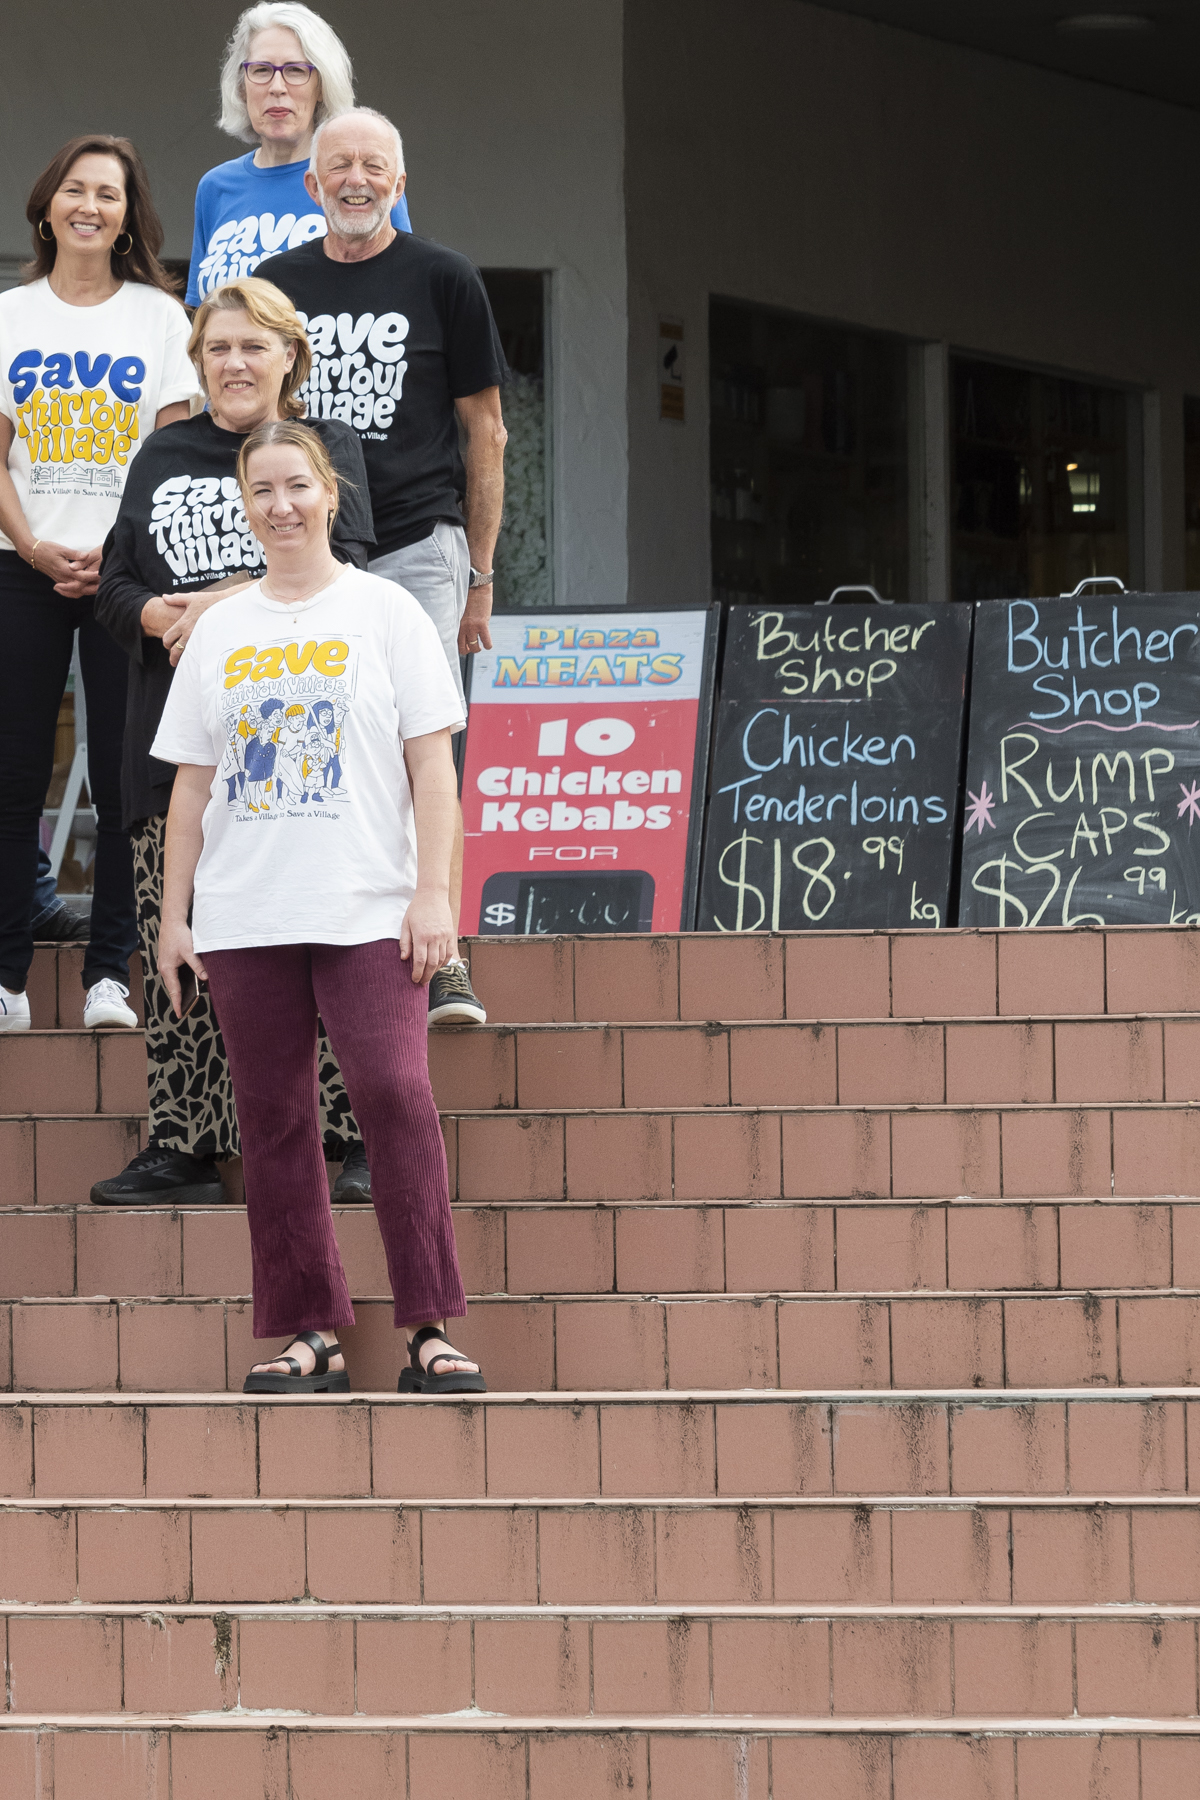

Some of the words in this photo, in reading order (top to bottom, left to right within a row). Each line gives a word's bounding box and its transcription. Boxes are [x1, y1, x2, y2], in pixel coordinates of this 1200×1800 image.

[303, 391, 396, 430] llage
[366, 432, 388, 441] Village
[82, 488, 97, 496] Save
[105, 490, 123, 500] Villa
[151, 475, 242, 520] Sav
[149, 500, 251, 555] Thirro
[523, 625, 660, 651] Plaza
[749, 611, 936, 660] Butcher
[1008, 600, 1198, 673] Butcher
[287, 675, 347, 695] Village
[492, 653, 685, 688] MEATS
[1029, 673, 1160, 724] Shop
[537, 717, 635, 757] 10
[742, 708, 916, 772] Chicken
[477, 765, 682, 797] Chicken
[717, 774, 948, 826] Tenderloins
[287, 810, 305, 818] Save
[313, 810, 340, 820] Village
[481, 800, 671, 832] Kebabs
[528, 846, 619, 861] FOR
[1013, 807, 1170, 863] CAPS
[911, 881, 940, 929] kg
